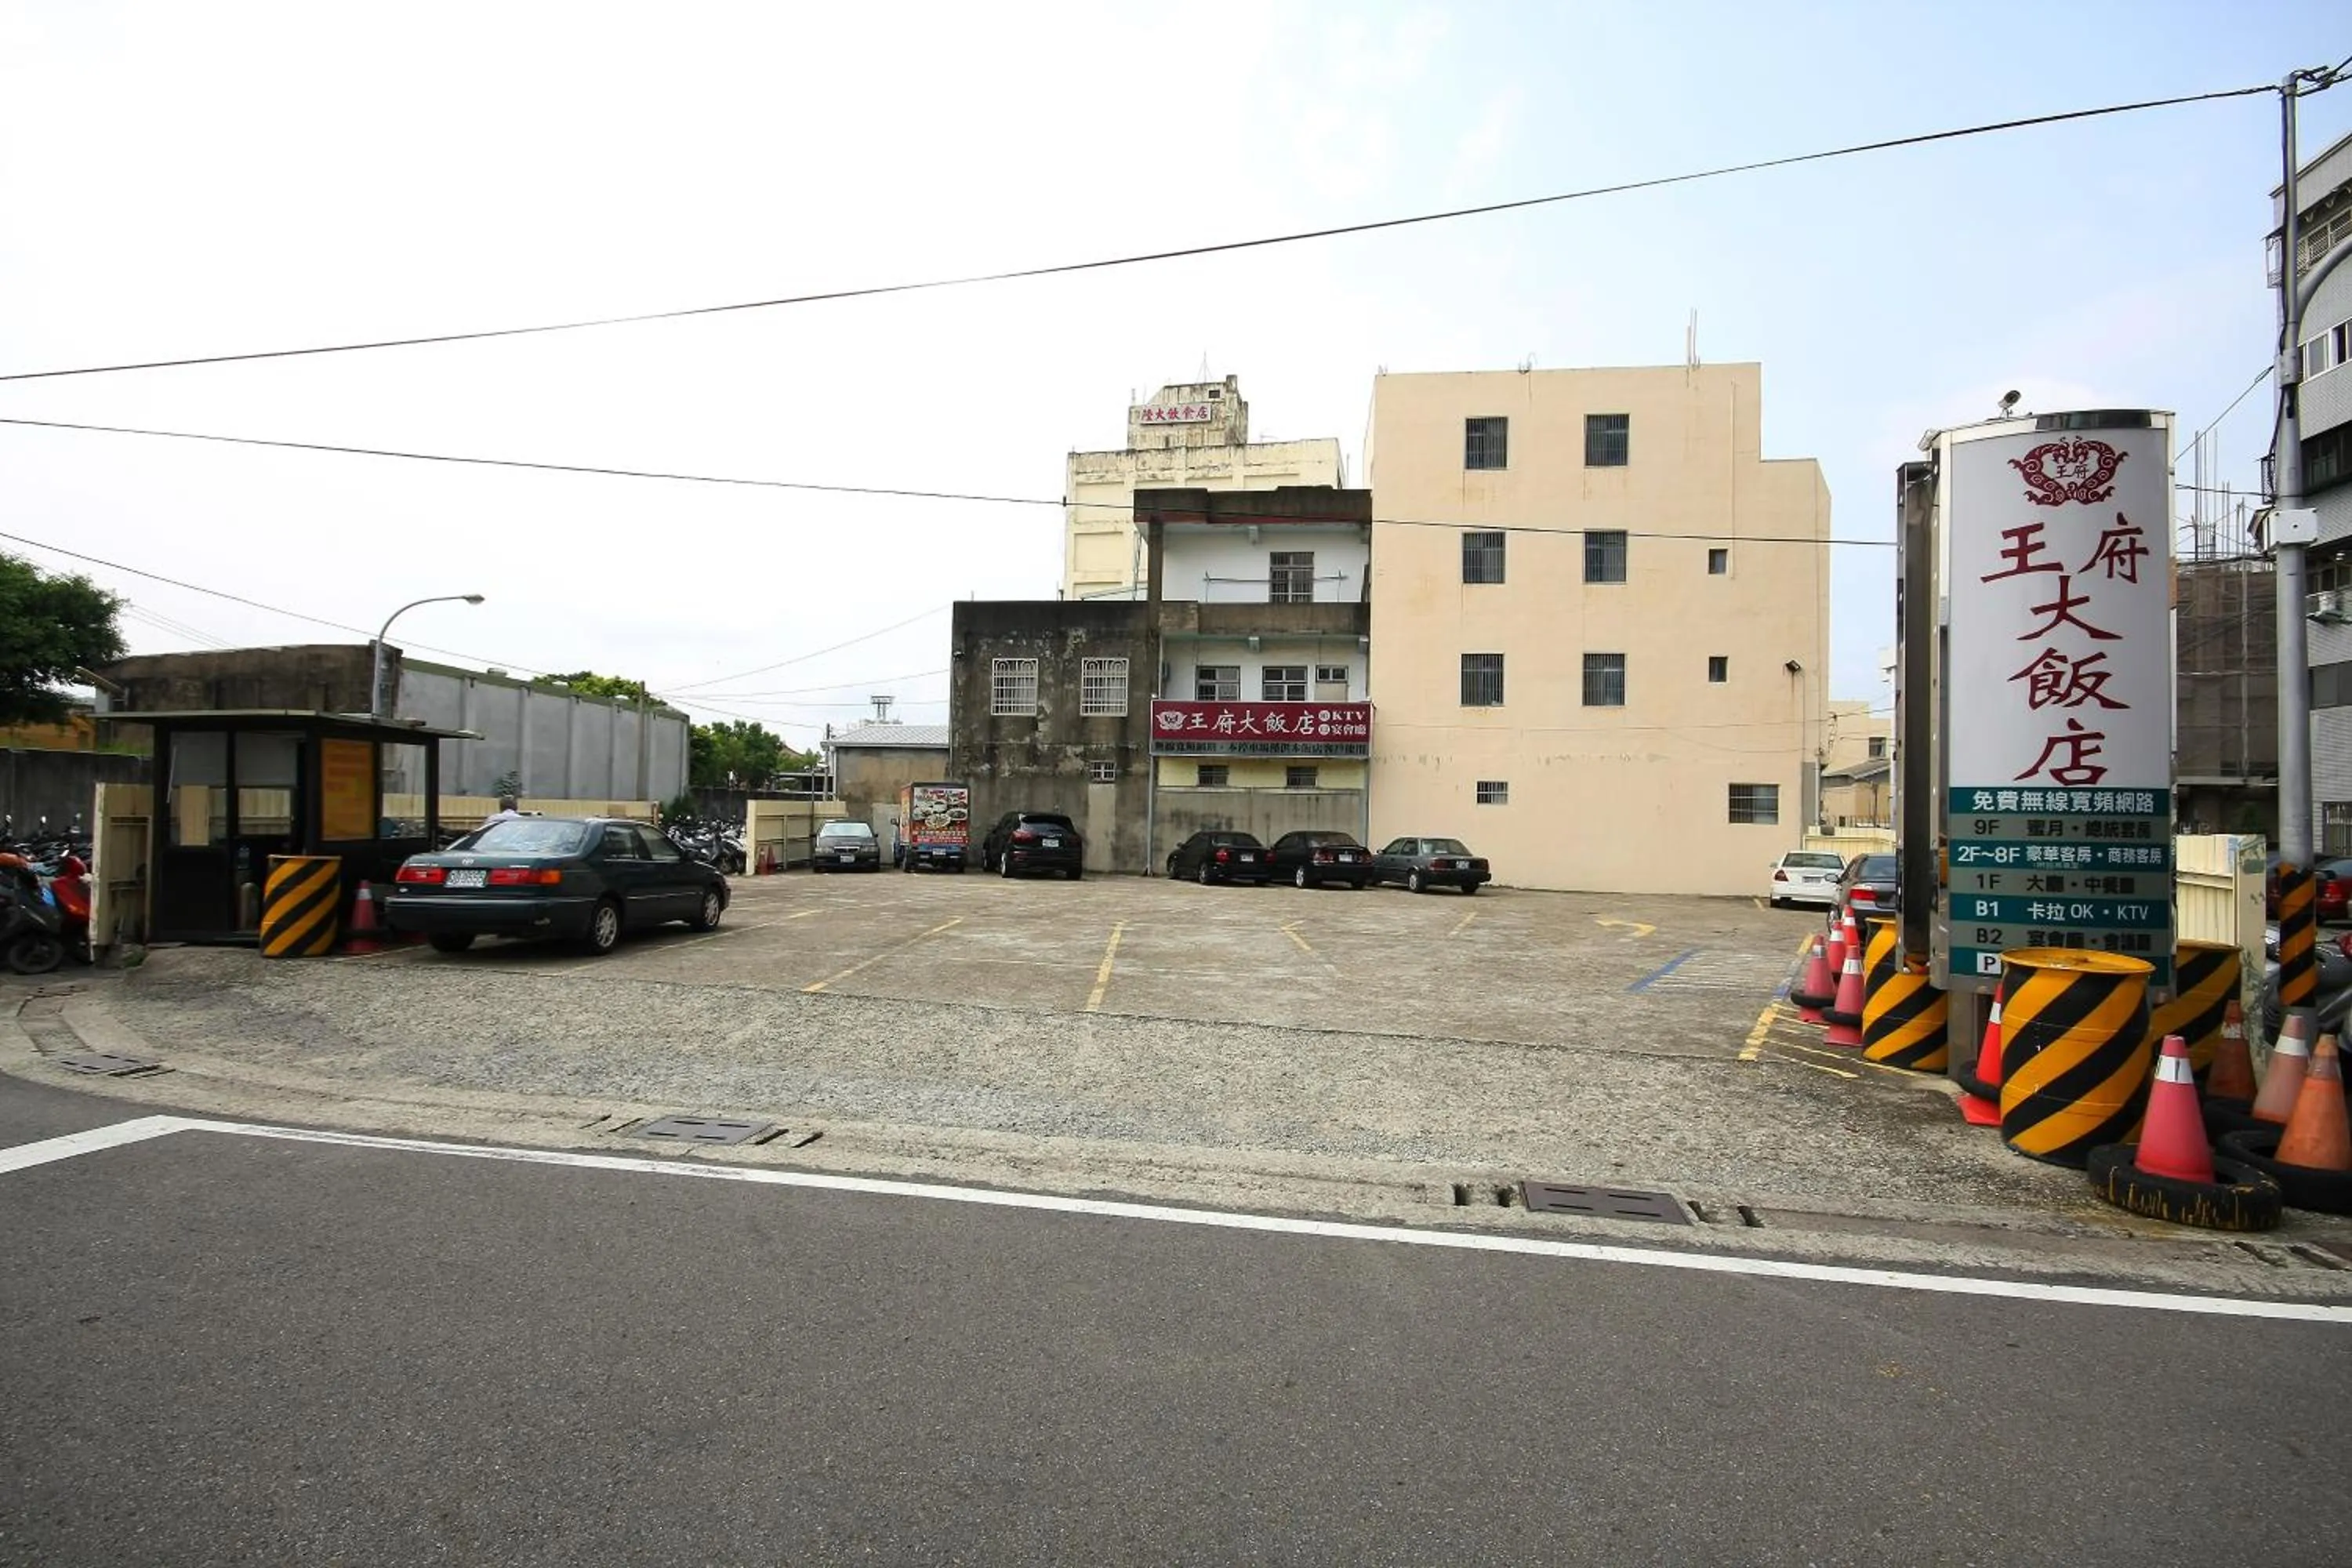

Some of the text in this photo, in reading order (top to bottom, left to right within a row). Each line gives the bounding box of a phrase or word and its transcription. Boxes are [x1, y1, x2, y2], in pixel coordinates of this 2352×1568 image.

[2056, 463, 2089, 479] 王府
[1186, 708, 1315, 735] 王府大飯店
[1331, 710, 1367, 721] KTV
[1972, 790, 2154, 813] 免費無線寬頻網路
[1974, 820, 2000, 835] 9F
[1958, 846, 2020, 863] 2F~8F
[1976, 874, 2002, 888] 1F
[1975, 901, 1999, 916] B1
[1976, 928, 2002, 944] B2
[1984, 956, 1997, 971] P
